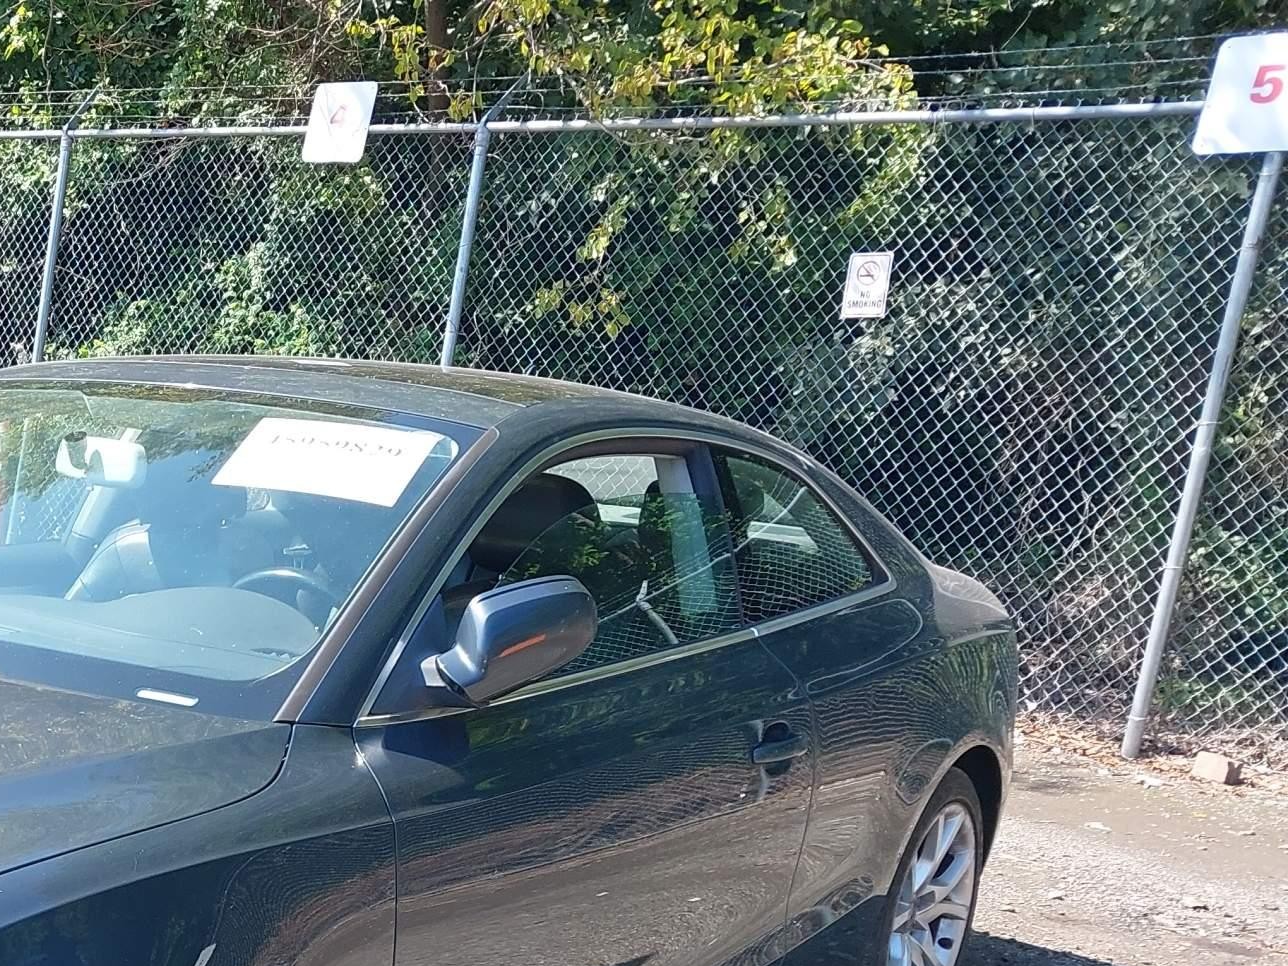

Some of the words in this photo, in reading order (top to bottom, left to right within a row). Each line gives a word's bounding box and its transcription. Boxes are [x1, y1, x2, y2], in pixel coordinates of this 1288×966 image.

[1250, 65, 1286, 104] 5
[860, 290, 870, 299] NO
[847, 299, 882, 309] SMOKING
